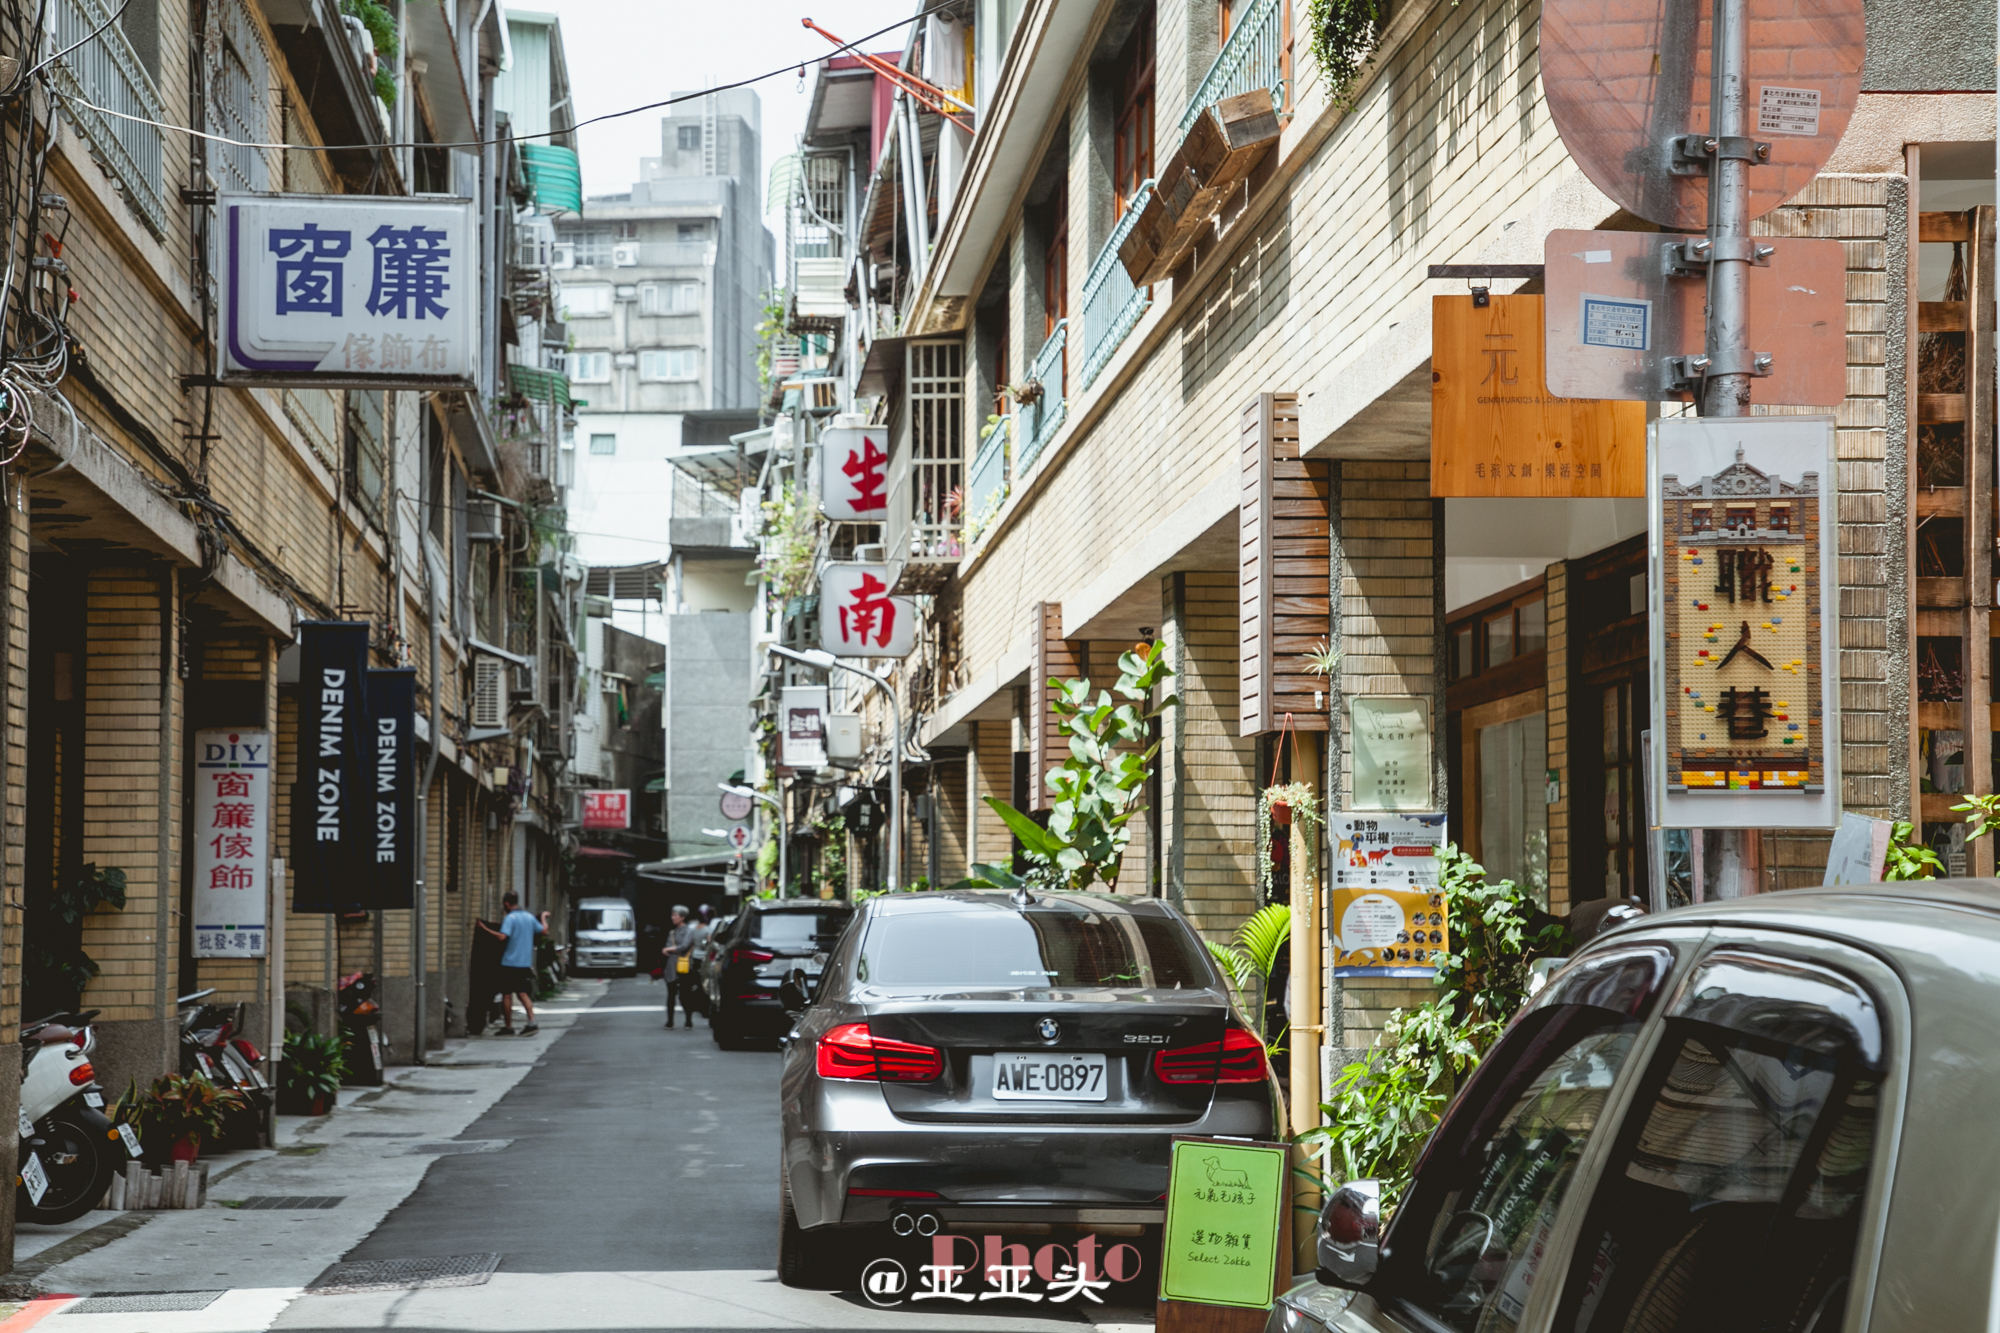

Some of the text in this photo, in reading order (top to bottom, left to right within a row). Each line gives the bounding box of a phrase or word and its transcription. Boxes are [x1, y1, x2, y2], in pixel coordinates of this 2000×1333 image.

[268, 222, 451, 321] 窗簾
[341, 331, 451, 371] 傢飾布
[1480, 333, 1519, 386] 元
[1615, 338, 1636, 346] 1999
[1534, 396, 1541, 404] &
[841, 435, 888, 513] 生
[839, 571, 897, 649] 南
[316, 667, 347, 842] DENIM ZONE
[376, 717, 398, 864] DENIM ZONE
[208, 771, 256, 891] 窗簾傢飾
[1353, 819, 1378, 832] 動物
[1365, 831, 1390, 845] 平權
[1193, 1187, 1257, 1206] 元氣毛孩子
[1187, 1251, 1252, 1267] Select Zakka
[1191, 1229, 1252, 1251] 選物雜貨
